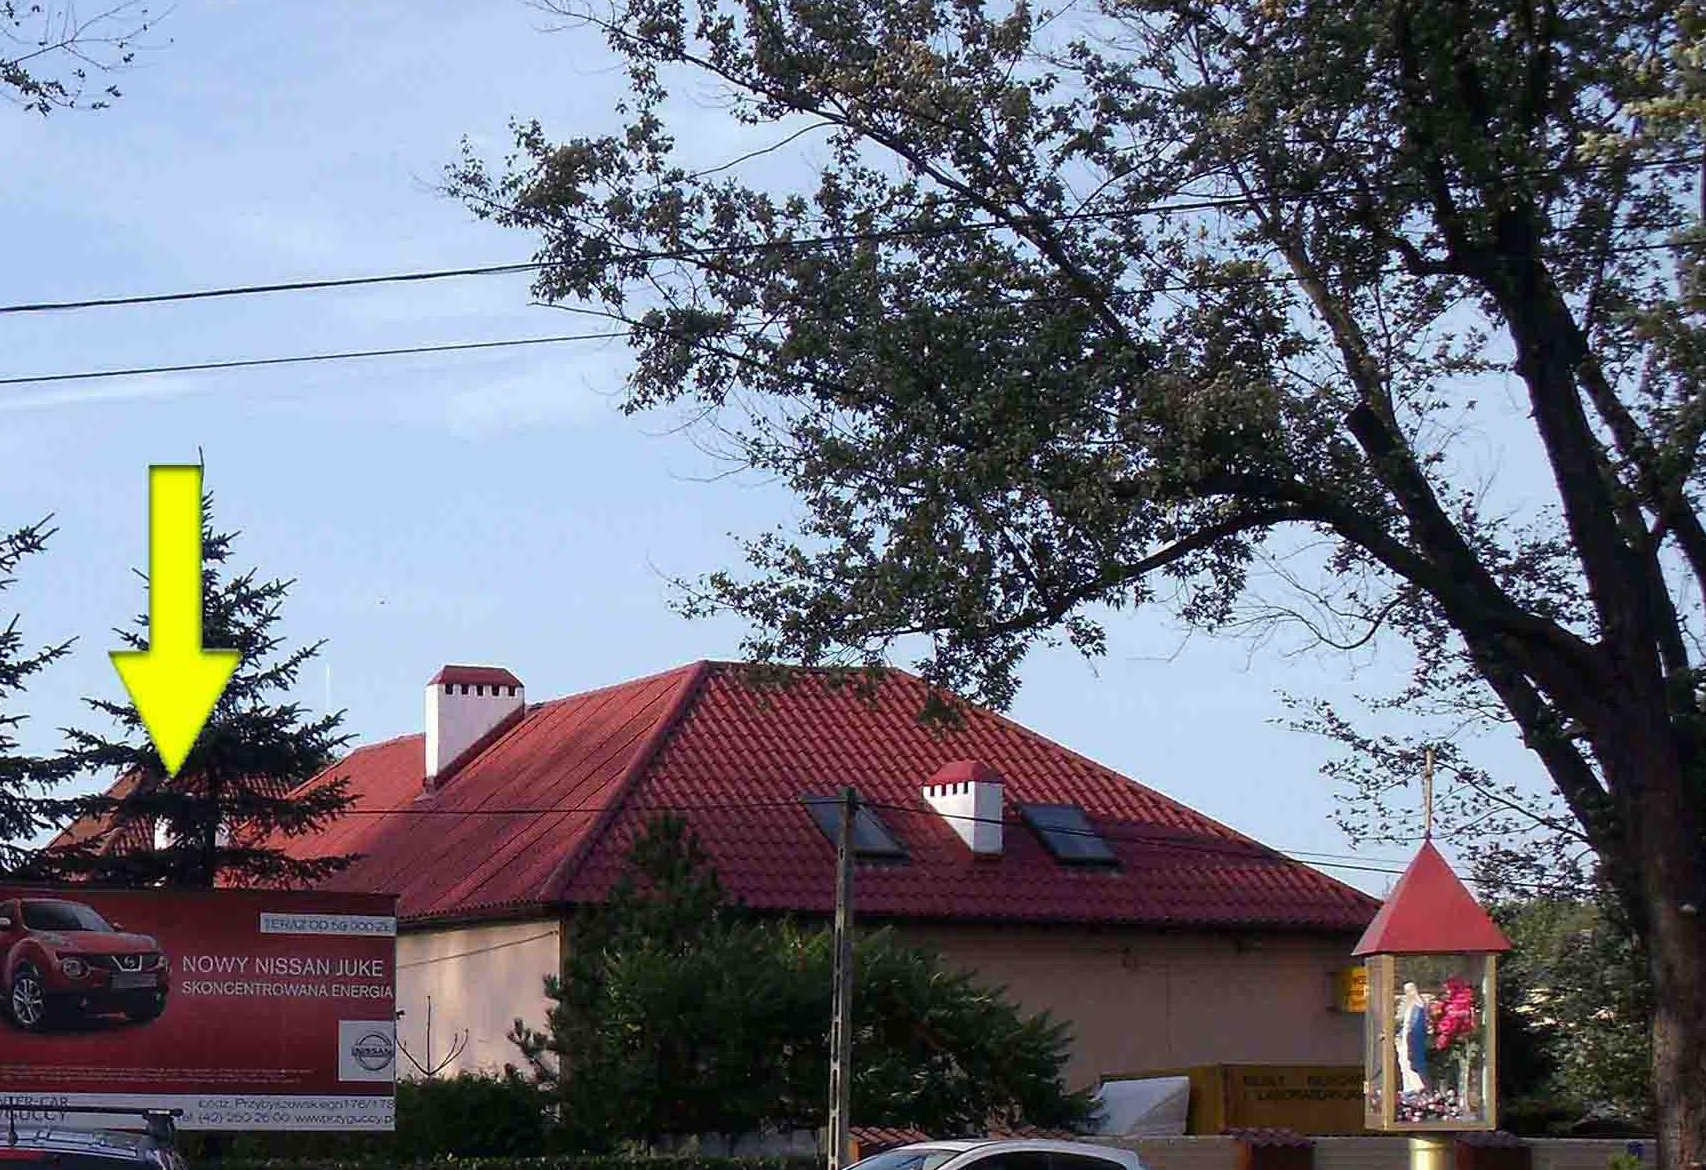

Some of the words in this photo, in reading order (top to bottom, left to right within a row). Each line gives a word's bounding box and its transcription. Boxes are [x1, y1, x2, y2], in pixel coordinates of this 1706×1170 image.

[182, 955, 248, 974] NOWY
[255, 957, 330, 976] NISSAN
[335, 959, 384, 977] JUKE
[181, 980, 327, 998] SKONCENTROWANA
[332, 983, 394, 999] ENERGIA
